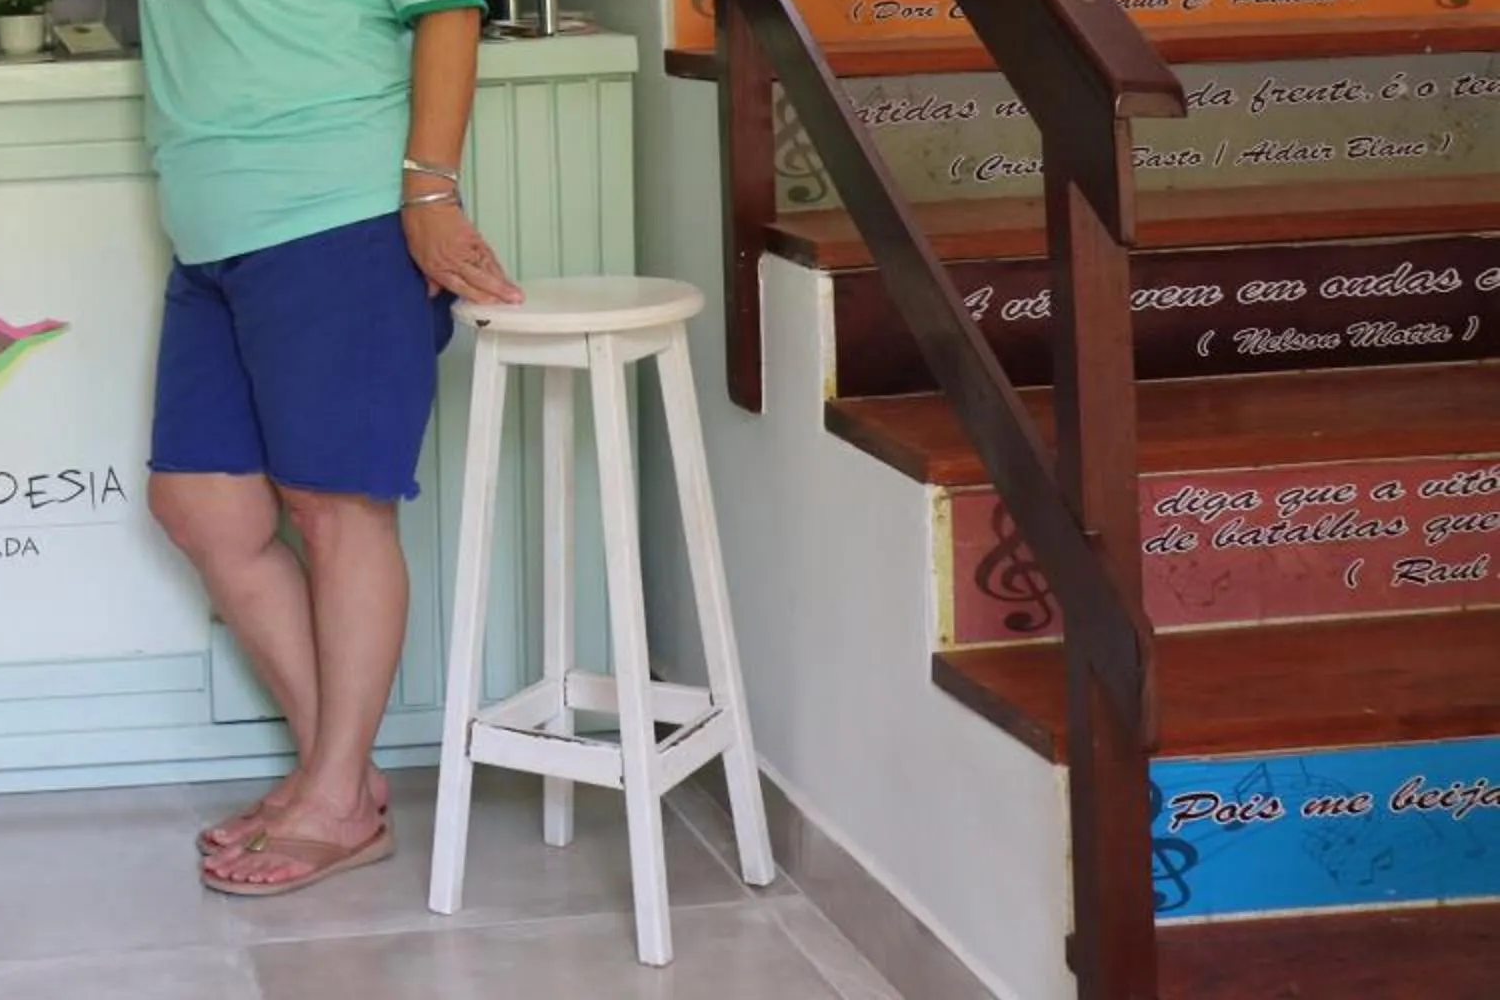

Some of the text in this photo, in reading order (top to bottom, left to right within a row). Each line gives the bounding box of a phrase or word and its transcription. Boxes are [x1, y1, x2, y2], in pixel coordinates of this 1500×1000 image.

[1414, 80, 1439, 99] o
[1347, 134, 1429, 160] Blanc
[1130, 285, 1224, 311] vem
[1236, 279, 1308, 305] em
[1320, 261, 1463, 299] ondas
[1233, 327, 1341, 355] Nelson
[1346, 320, 1454, 348] Motta
[1155, 485, 1260, 523] diga
[1276, 481, 1358, 518] que
[1370, 478, 1406, 501] a
[1142, 509, 1500, 555] de batalhas que
[1391, 551, 1491, 588] Raul
[1168, 790, 1288, 833] Pois
[1300, 791, 1375, 820] me
